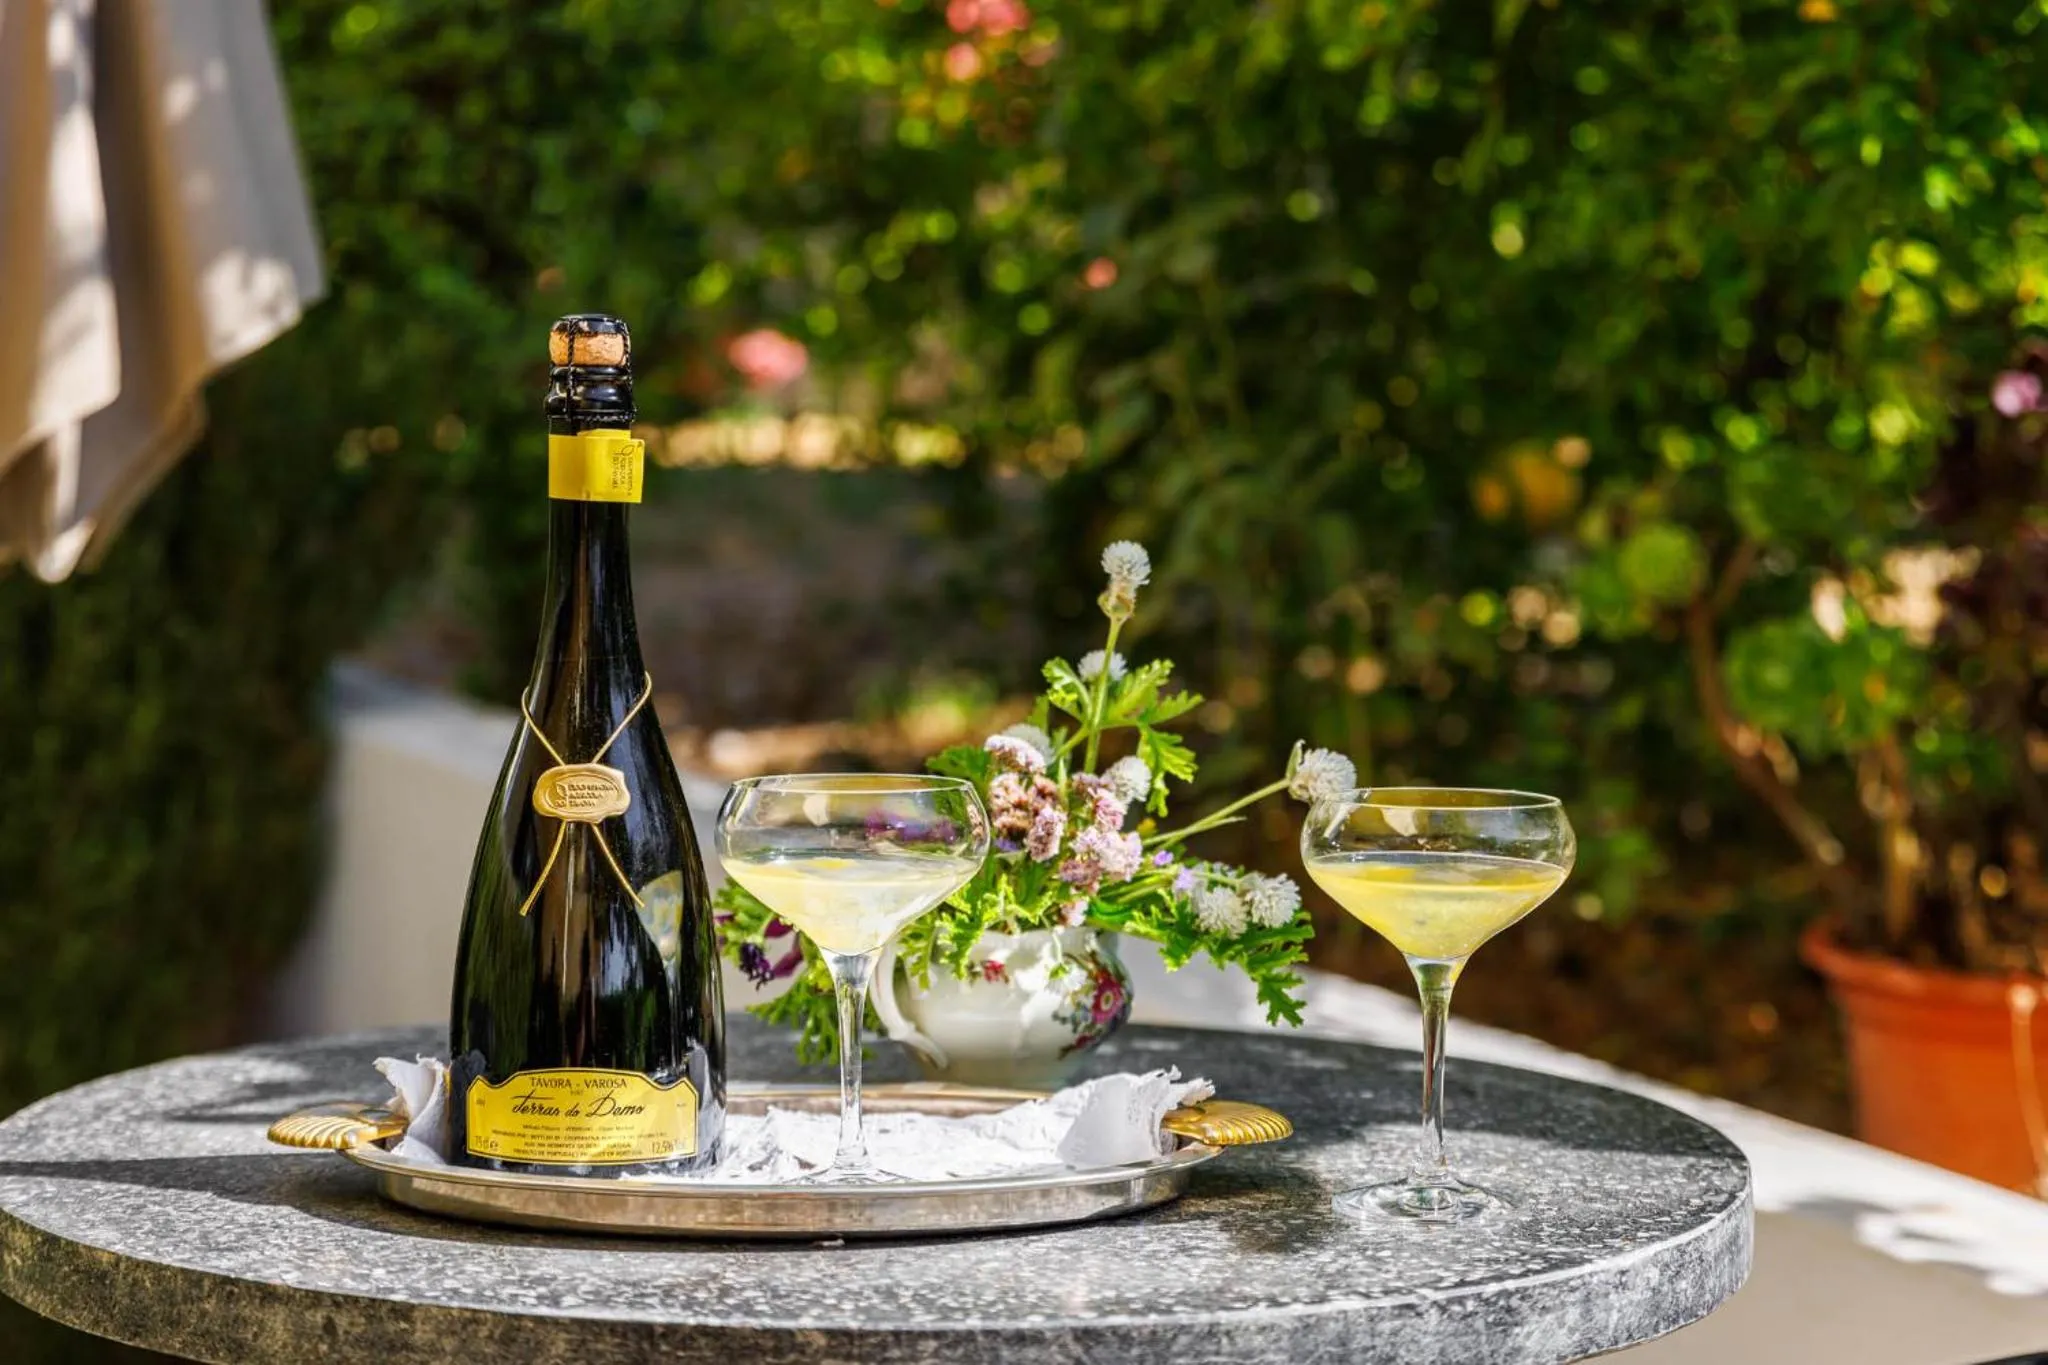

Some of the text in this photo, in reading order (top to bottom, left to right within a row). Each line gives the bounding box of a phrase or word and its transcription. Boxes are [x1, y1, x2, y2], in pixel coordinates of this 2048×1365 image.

[584, 1078, 627, 1090] VAROSA
[564, 1102, 580, 1117] do
[585, 1089, 647, 1118] Demo
